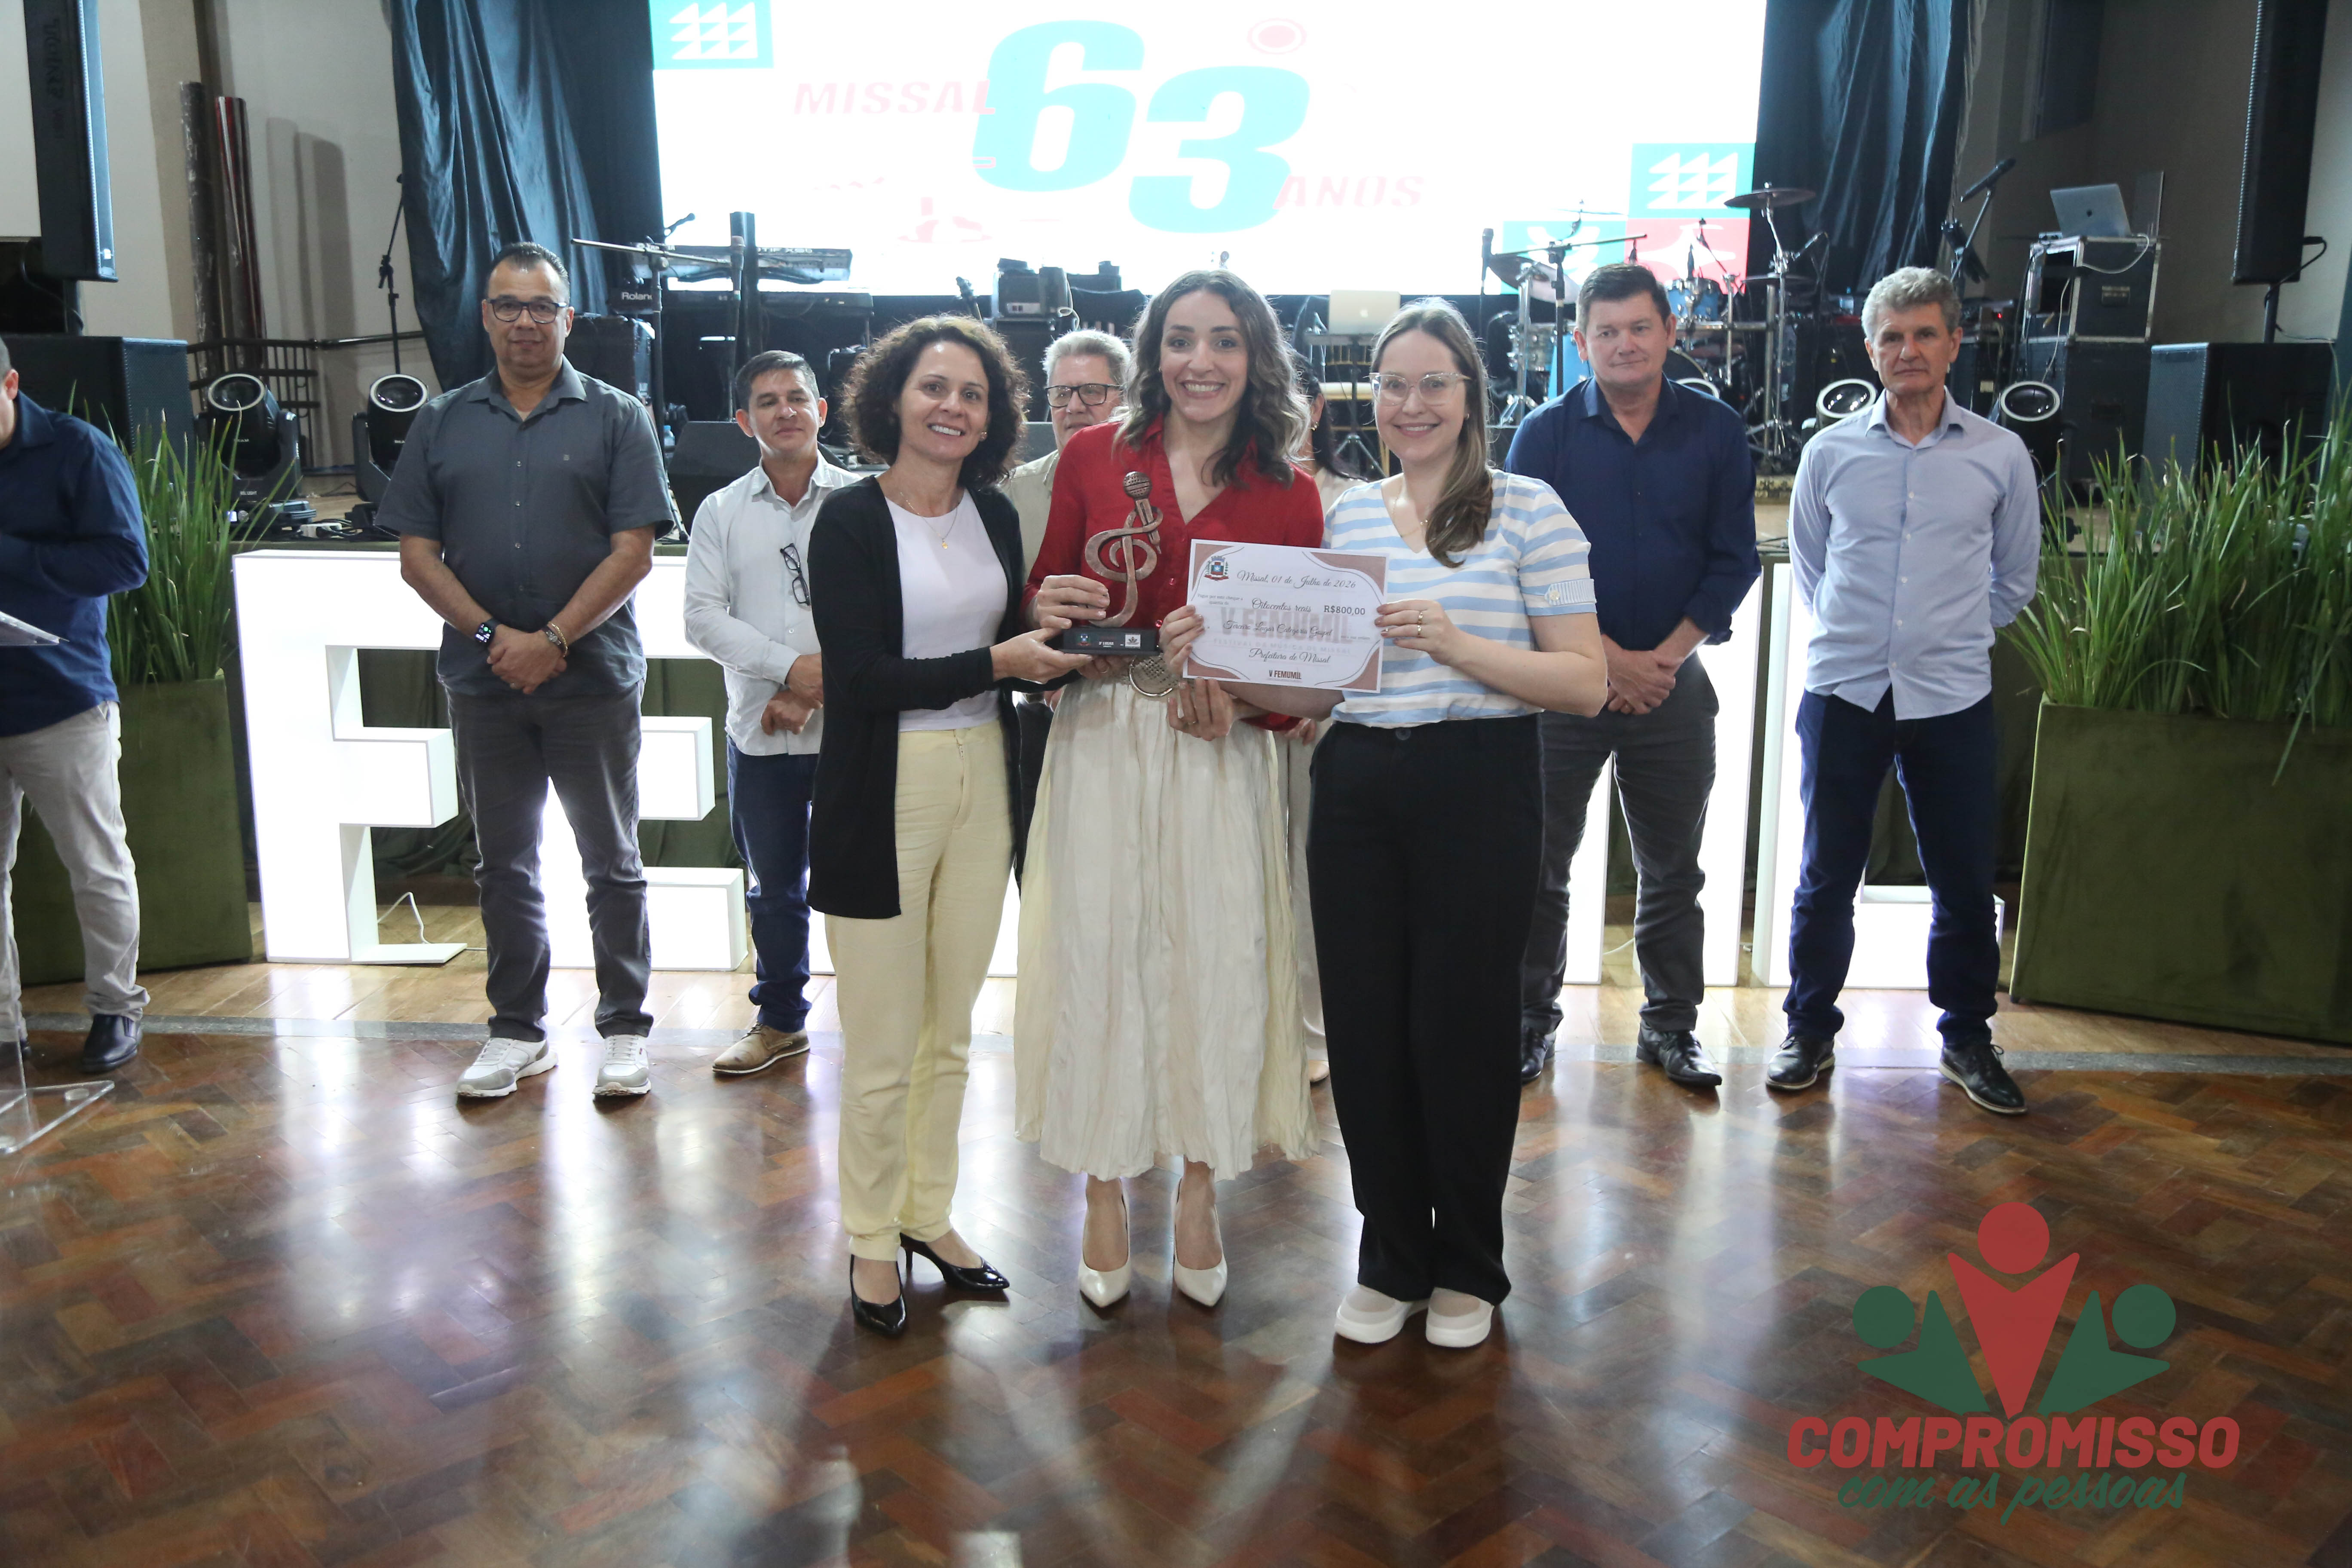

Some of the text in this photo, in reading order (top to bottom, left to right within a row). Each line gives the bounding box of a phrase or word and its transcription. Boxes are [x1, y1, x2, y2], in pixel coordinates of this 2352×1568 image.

[793, 78, 996, 115] MISSAL
[972, 20, 1311, 233] 63
[1237, 570, 1268, 583] Missal,
[1293, 575, 1320, 588] Julho
[1323, 578, 1331, 586] de
[1333, 580, 1356, 588] 2026
[1252, 598, 1311, 612] Oitocentos reais
[1324, 605, 1366, 616] R$800,00
[1249, 648, 1286, 662] Prefeitura
[1299, 652, 1331, 663] Missal
[1274, 671, 1302, 680] FEMUMIL
